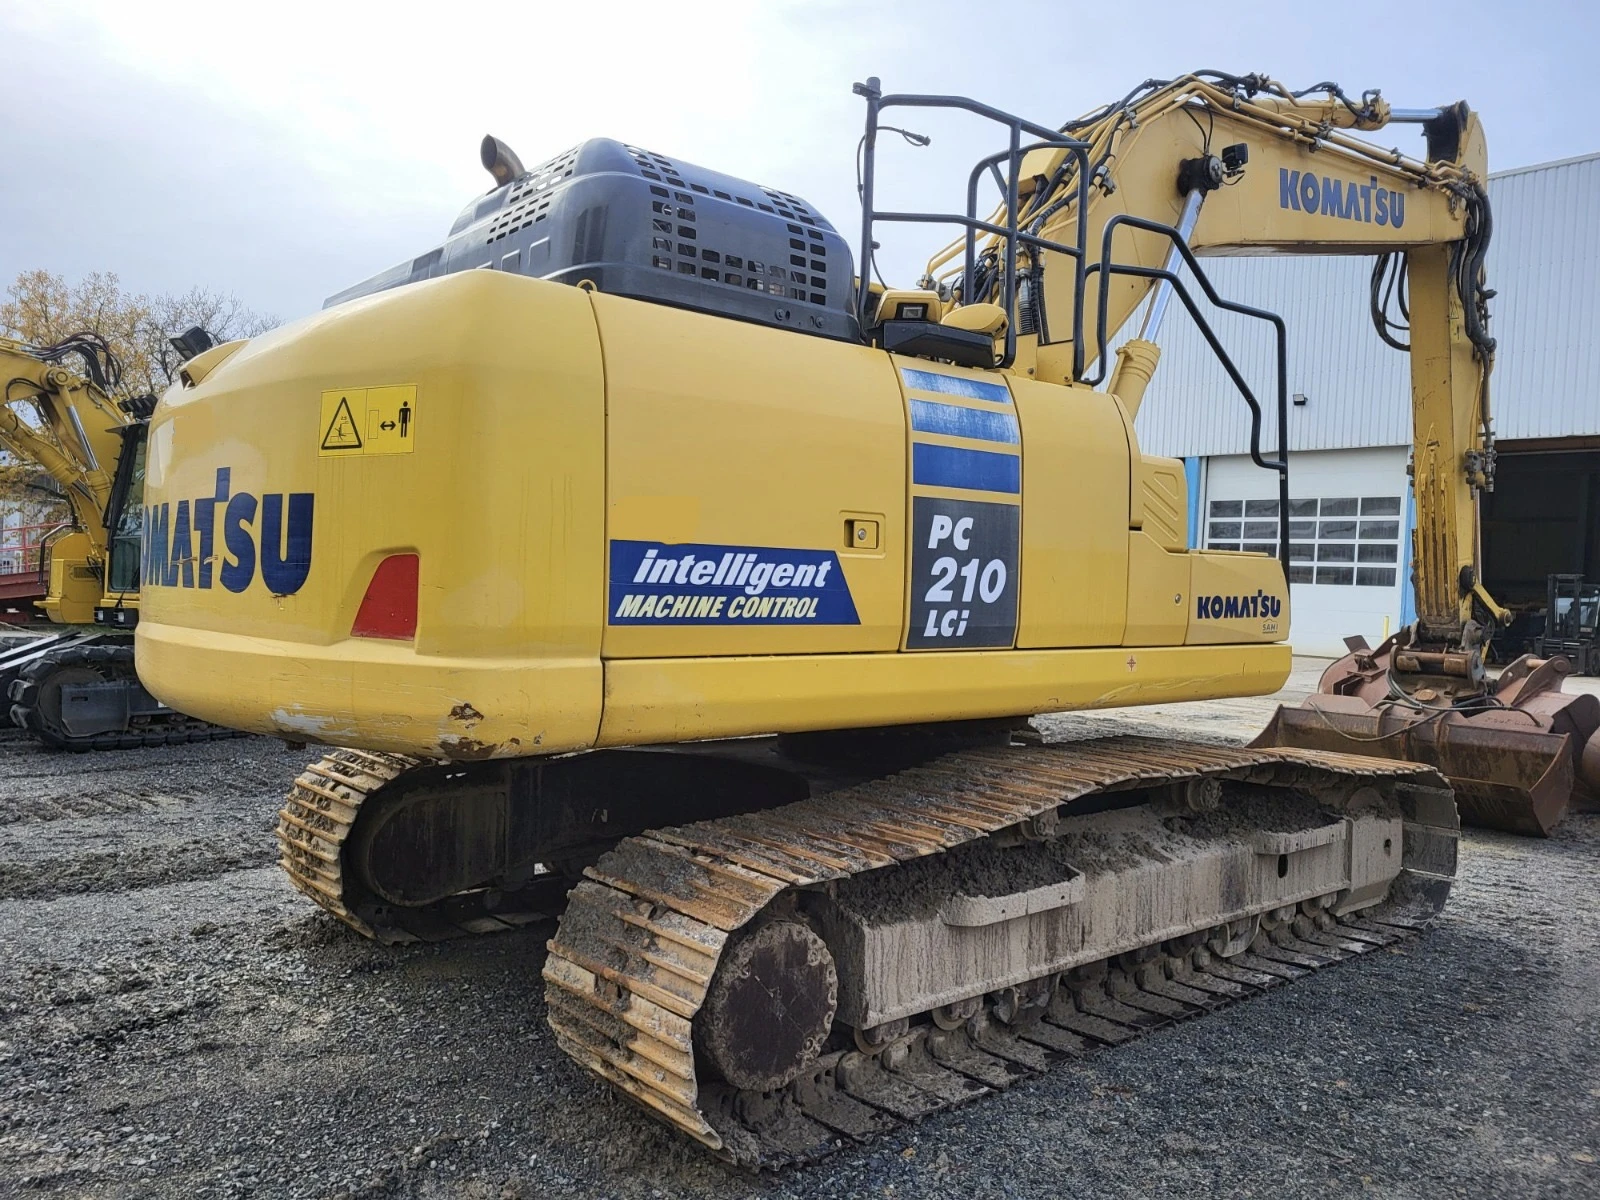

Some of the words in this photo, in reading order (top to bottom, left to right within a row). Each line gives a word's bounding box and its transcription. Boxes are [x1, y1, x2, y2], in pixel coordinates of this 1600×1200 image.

[1279, 168, 1405, 229] KOMATSU
[141, 467, 315, 595] OMATSU
[928, 514, 974, 550] PC
[633, 549, 832, 595] intelligent
[924, 557, 1007, 604] 210
[615, 595, 724, 618] MACHINE
[727, 597, 819, 618] CONTROL
[923, 609, 968, 637] LCi
[1197, 589, 1281, 619] KOMATSU
